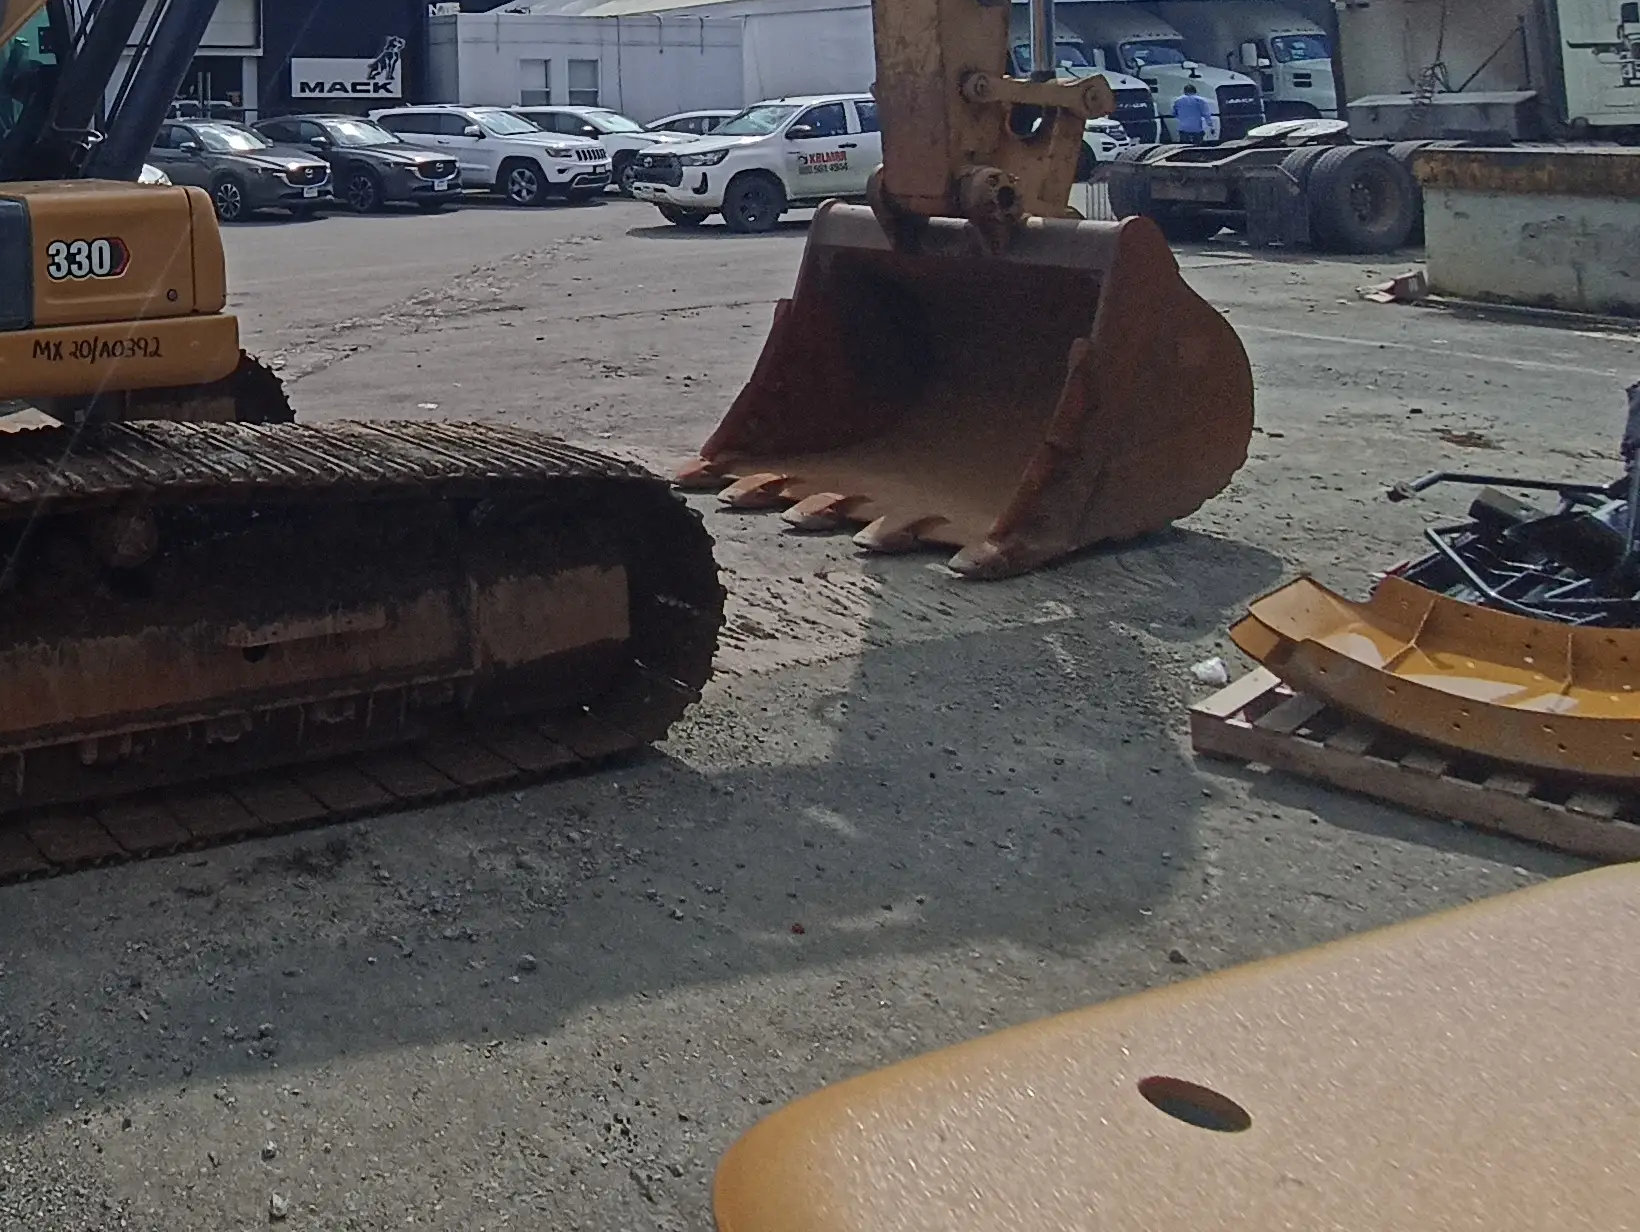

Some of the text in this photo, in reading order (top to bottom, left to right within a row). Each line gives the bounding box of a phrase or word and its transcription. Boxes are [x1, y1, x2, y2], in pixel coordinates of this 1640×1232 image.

[300, 82, 393, 94] MACK
[48, 239, 110, 277] 330
[32, 339, 63, 361] MX
